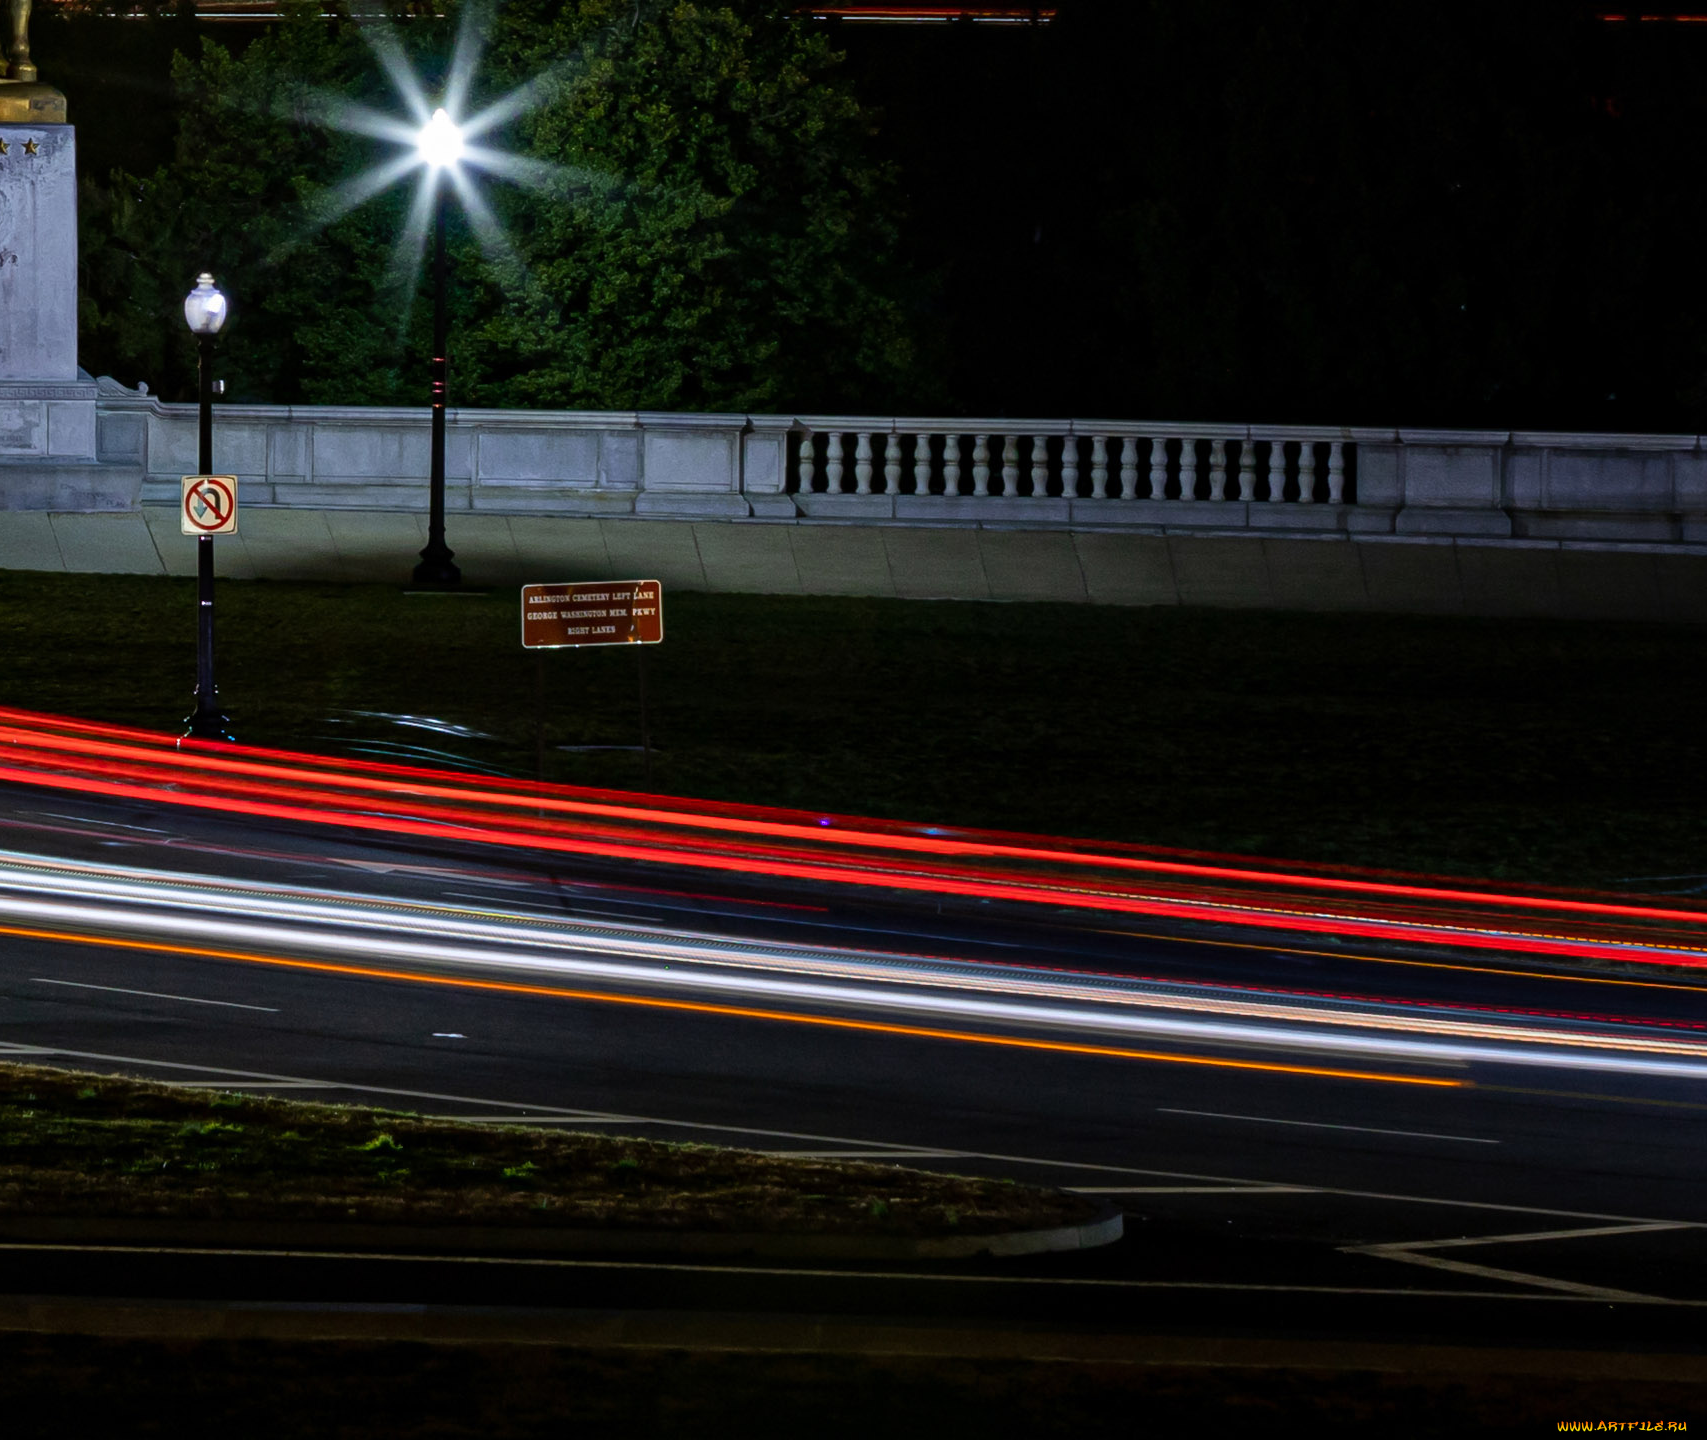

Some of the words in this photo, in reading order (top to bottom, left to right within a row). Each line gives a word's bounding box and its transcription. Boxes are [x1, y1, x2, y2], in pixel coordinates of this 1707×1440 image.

[528, 595, 570, 604] ARLINGTON
[572, 592, 610, 602] CEMETERY
[612, 591, 631, 600] LEFT
[527, 611, 558, 621] GEORGE
[560, 609, 607, 619] WASHINGTON
[632, 608, 656, 616] PKWY
[567, 627, 589, 635] RIGHT
[592, 626, 615, 634] LANES
